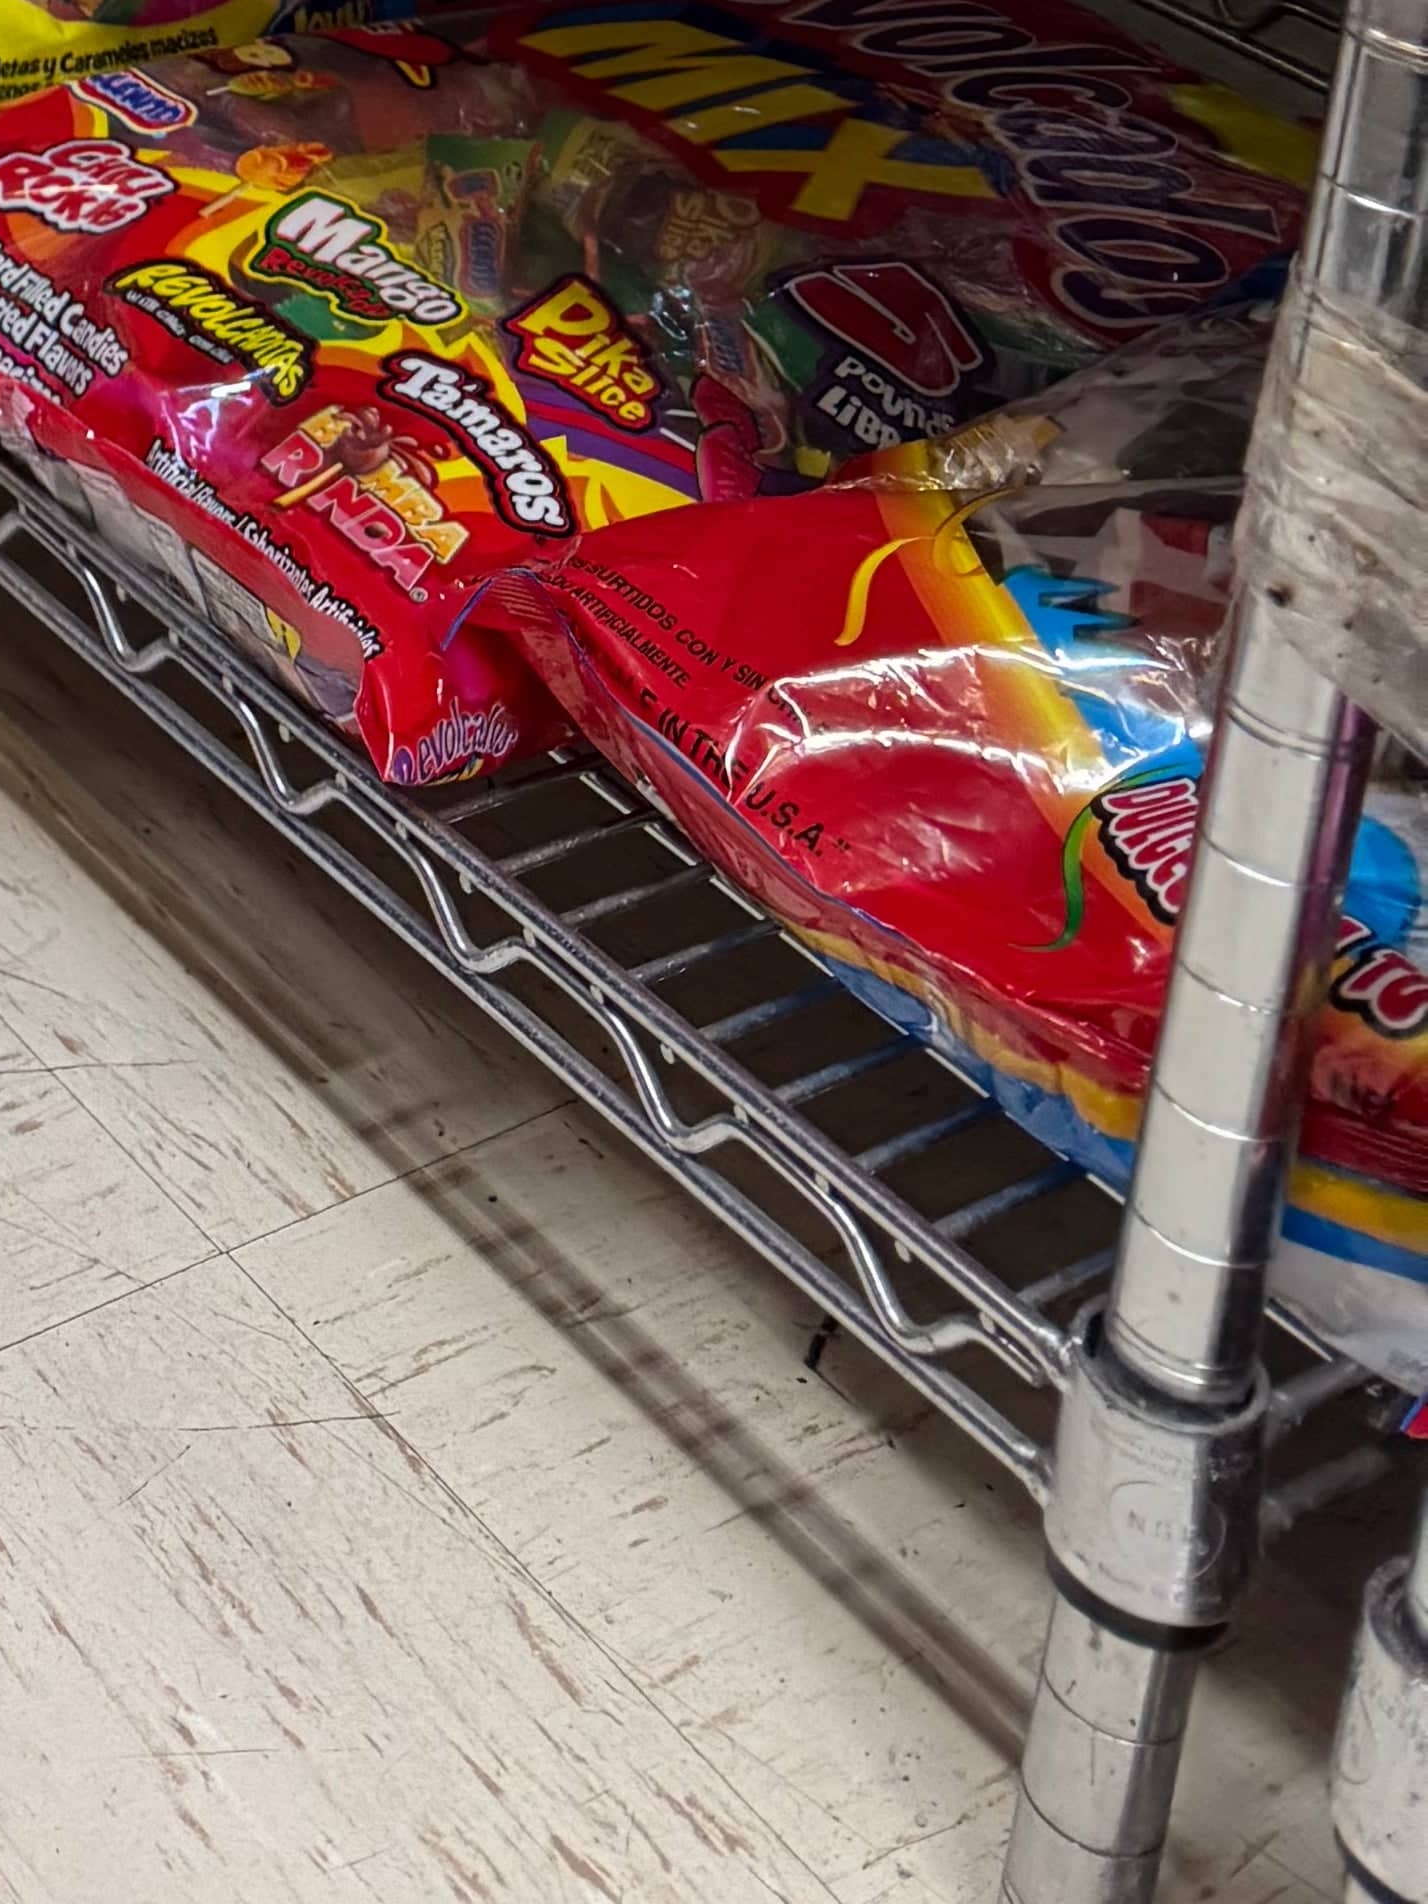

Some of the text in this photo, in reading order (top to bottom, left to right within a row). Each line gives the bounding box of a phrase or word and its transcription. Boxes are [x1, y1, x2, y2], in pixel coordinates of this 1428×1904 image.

[44, 58, 58, 81] y
[59, 43, 148, 76] Caramelos
[521, 16, 1002, 222] MIX
[274, 197, 460, 324] Mango
[12, 263, 71, 325] Filled
[59, 302, 130, 377] Candies
[24, 319, 93, 398] Flavors
[520, 281, 655, 395] Pika
[529, 333, 649, 425] Slice
[145, 438, 195, 496] Artificial
[243, 520, 316, 604] Saborizantes
[309, 583, 384, 661] Artificiales
[570, 582, 692, 690] ARTIFICIALMENTE
[595, 565, 768, 693] SURTIDOS CON Y SIN
[657, 708, 691, 744] IN
[691, 727, 748, 784] THE
